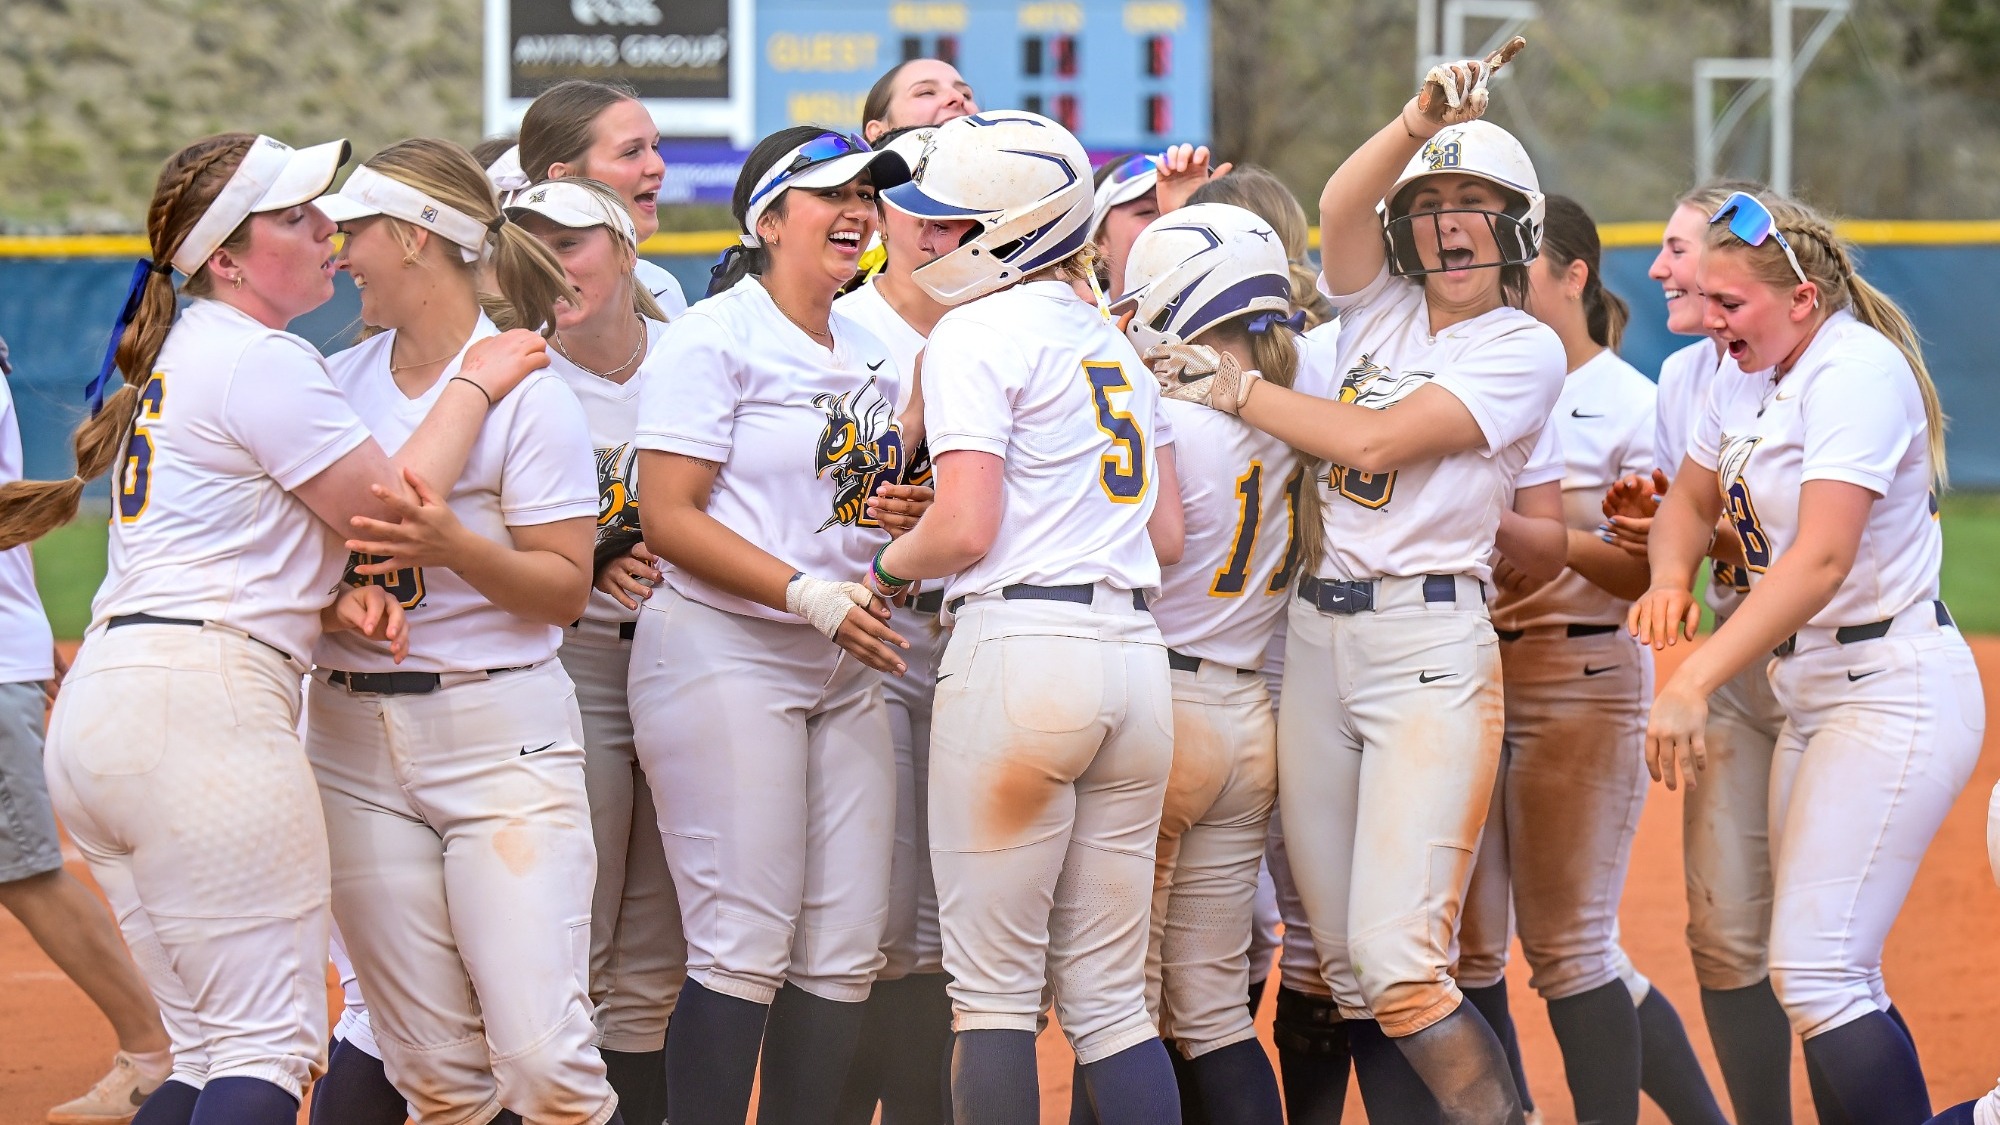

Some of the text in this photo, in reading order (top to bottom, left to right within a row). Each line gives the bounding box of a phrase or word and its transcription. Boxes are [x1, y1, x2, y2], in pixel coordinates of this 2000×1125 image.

[620, 34, 727, 67] GROUP
[770, 33, 876, 71] GUEST
[790, 92, 867, 126] MSU
[1442, 140, 1462, 168] B
[110, 372, 167, 524] 6
[1082, 360, 1149, 504] 5
[1208, 460, 1304, 597] 11
[1724, 475, 1772, 574] B
